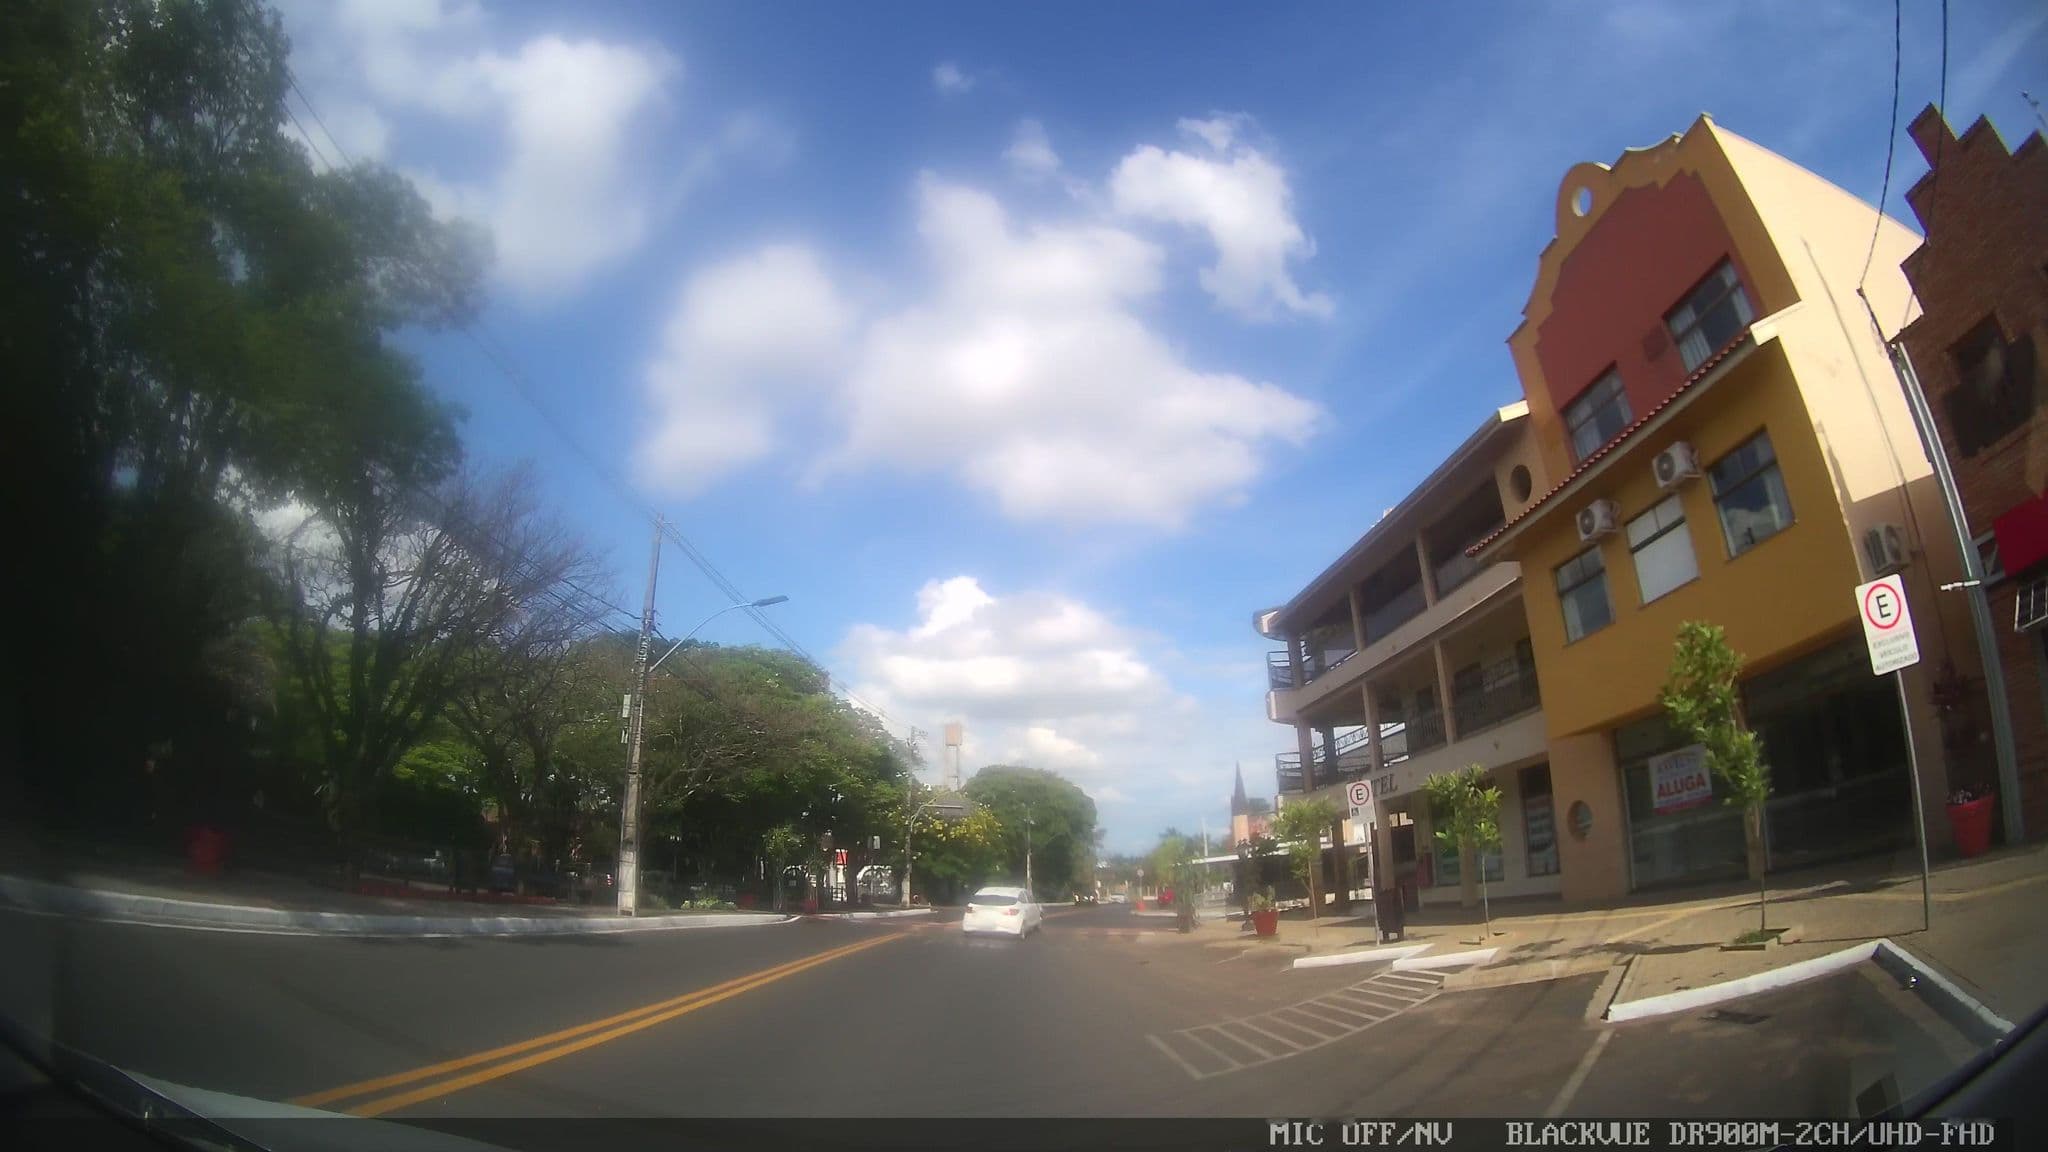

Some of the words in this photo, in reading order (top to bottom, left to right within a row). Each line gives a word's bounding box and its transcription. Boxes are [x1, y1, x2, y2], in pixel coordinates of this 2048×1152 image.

[1876, 593, 1891, 619] E
[1355, 788, 1364, 801] E
[1371, 773, 1398, 797] TEL
[1657, 772, 1706, 798] ALUGA
